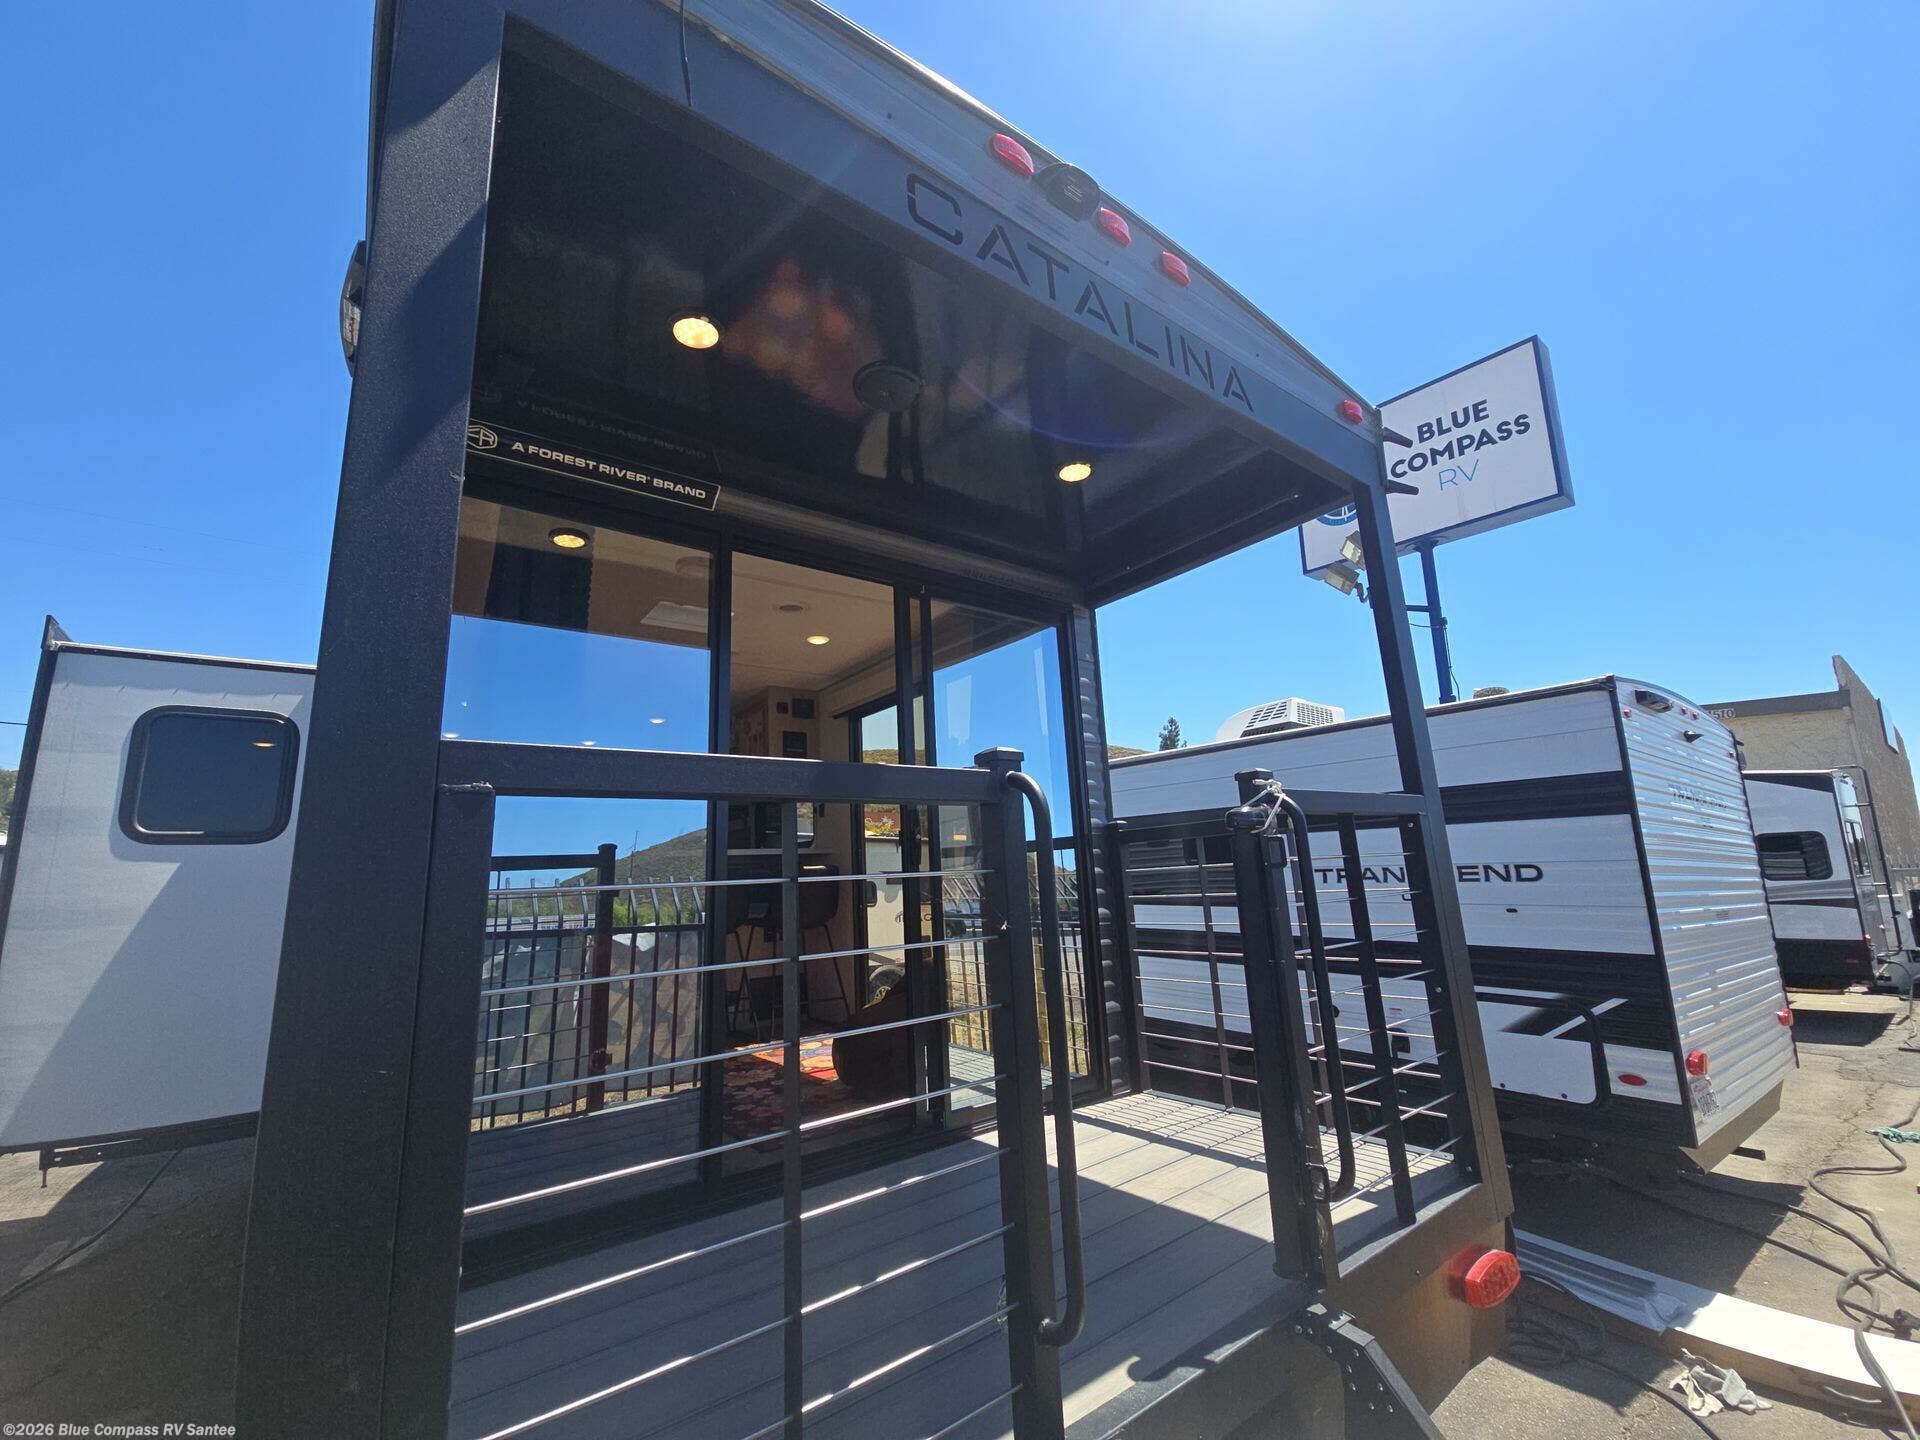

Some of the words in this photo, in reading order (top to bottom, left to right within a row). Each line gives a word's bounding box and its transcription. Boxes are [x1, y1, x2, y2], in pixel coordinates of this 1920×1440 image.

[906, 173, 1254, 412] CATALINA
[1390, 414, 1531, 478] COMPASS
[1416, 399, 1490, 444] BLUE
[511, 441, 525, 453] A
[528, 445, 597, 470] FOREST
[653, 477, 706, 499] BRAND
[1438, 459, 1479, 491] RV
[1314, 863, 1544, 884] TANEND
